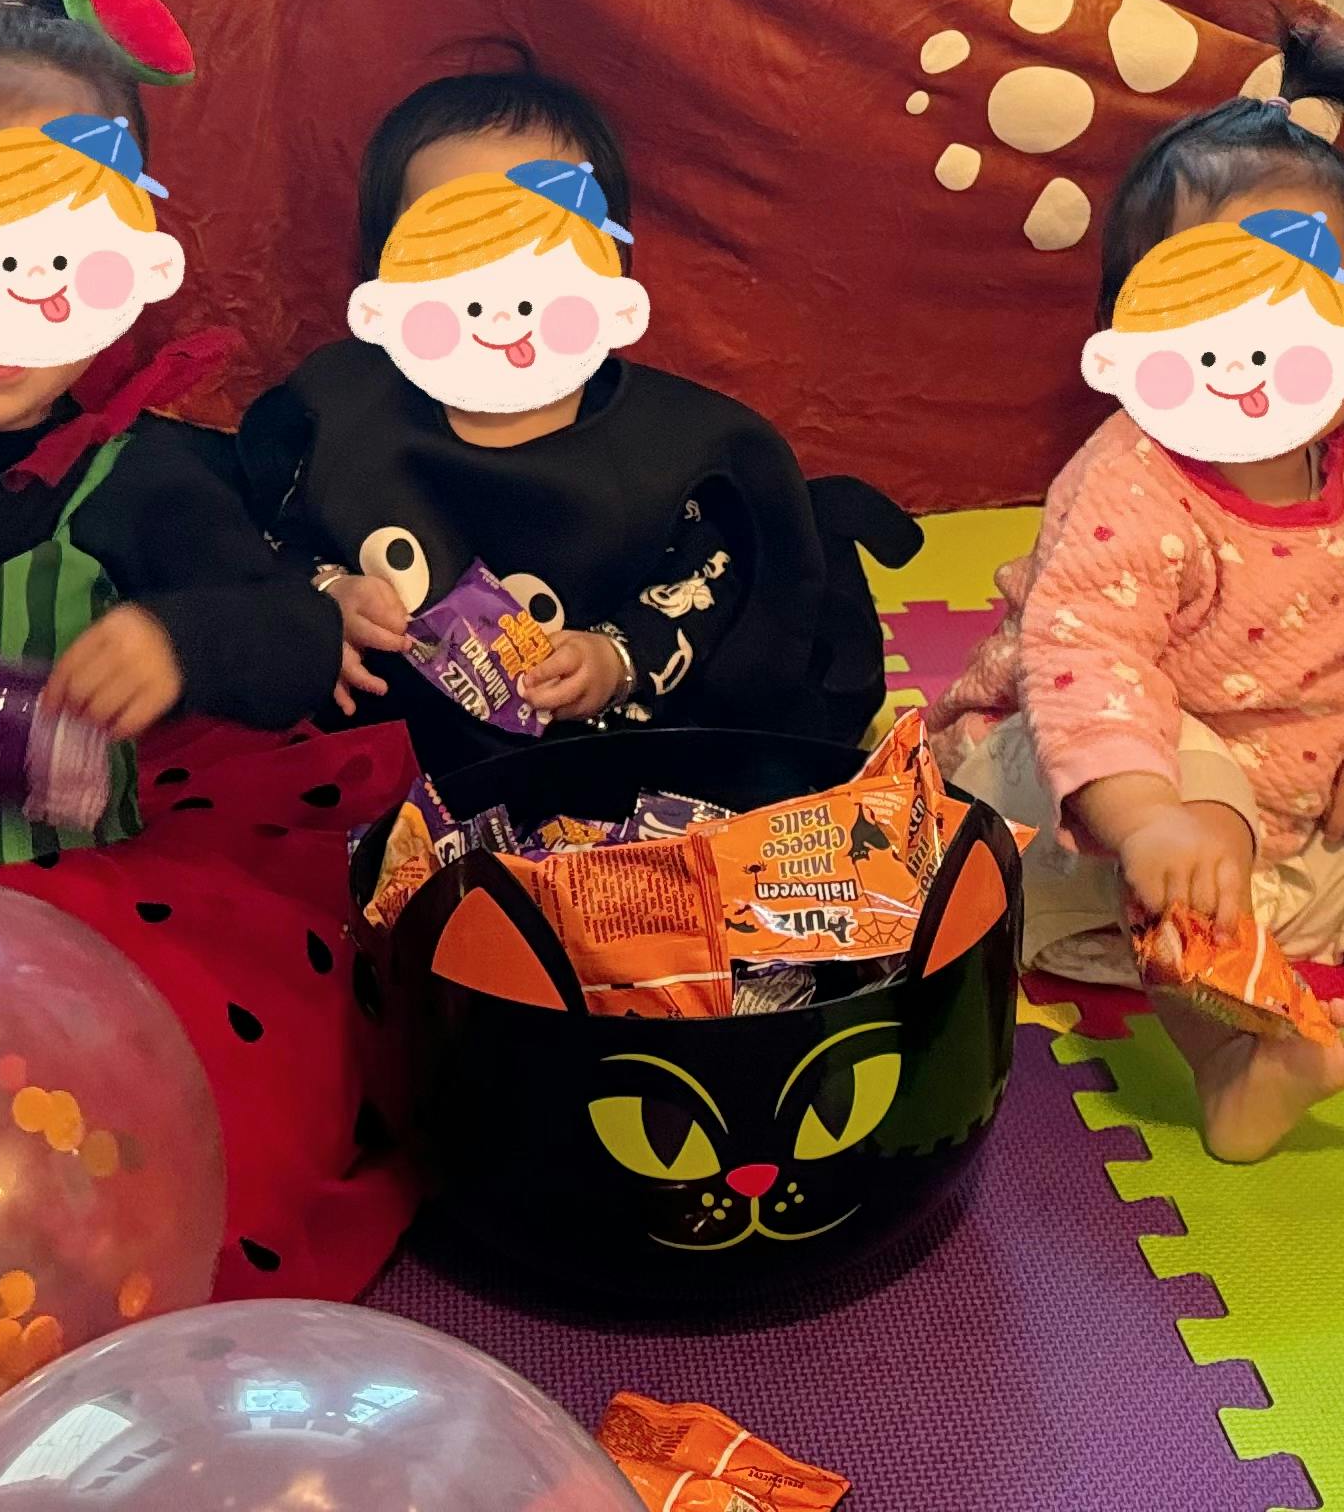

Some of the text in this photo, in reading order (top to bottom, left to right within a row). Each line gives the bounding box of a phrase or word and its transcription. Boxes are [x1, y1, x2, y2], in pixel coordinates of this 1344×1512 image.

[460, 636, 512, 711] Halloween
[770, 801, 832, 834] Balls
[762, 826, 847, 859] Cheese
[779, 852, 836, 879] Mini
[757, 879, 857, 901] Halloween
